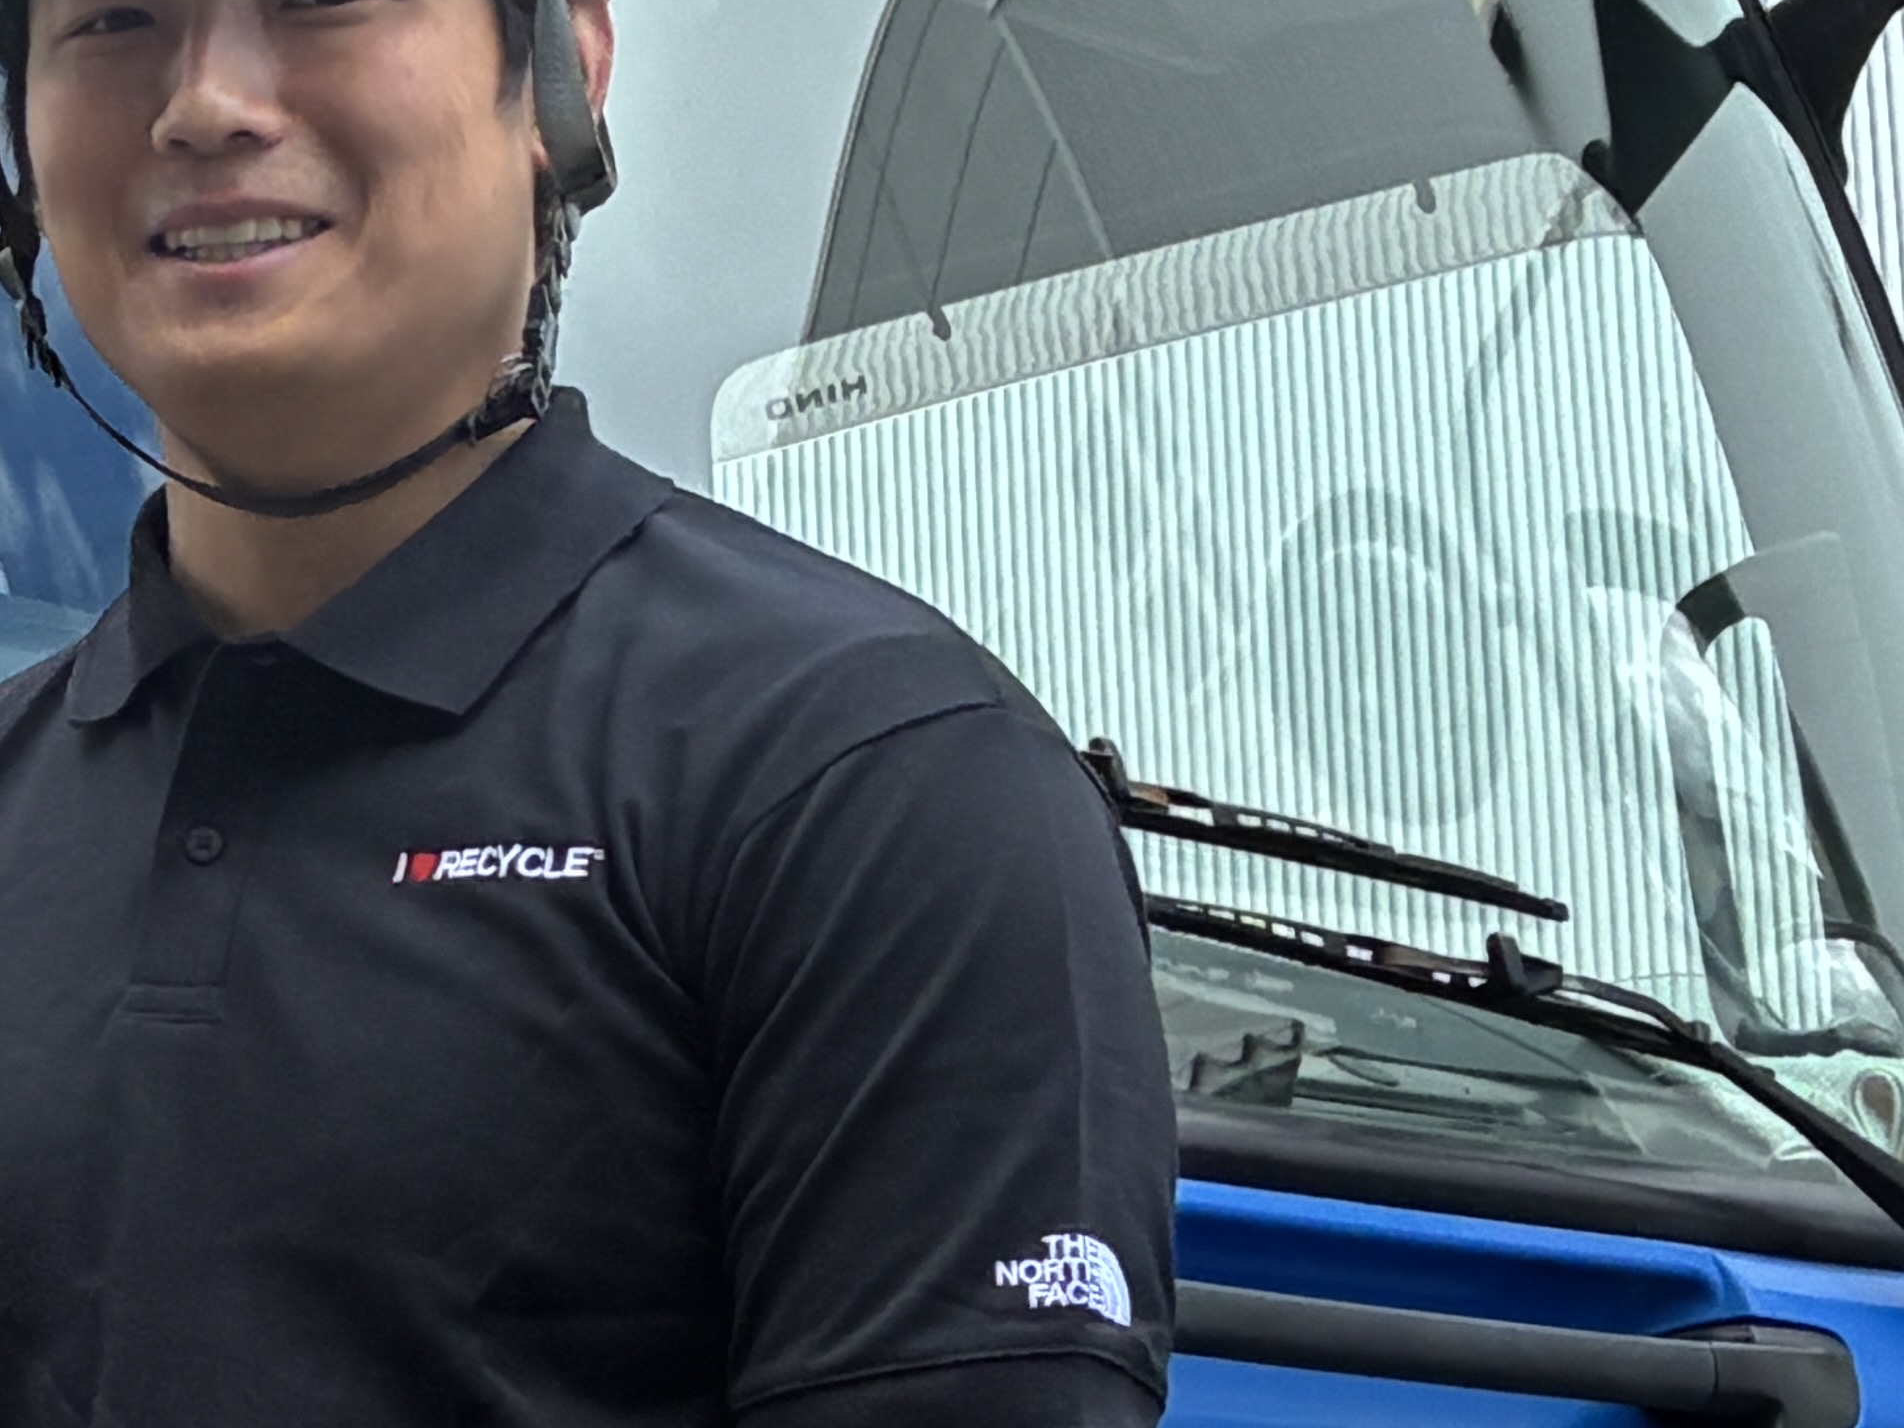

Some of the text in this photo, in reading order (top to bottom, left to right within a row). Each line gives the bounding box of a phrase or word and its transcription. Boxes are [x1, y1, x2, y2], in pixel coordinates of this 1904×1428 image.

[432, 843, 595, 881] RECYCLE
[1041, 1233, 1101, 1259] THE
[995, 1258, 1102, 1287] NORTH
[1028, 1282, 1106, 1310] FACE
